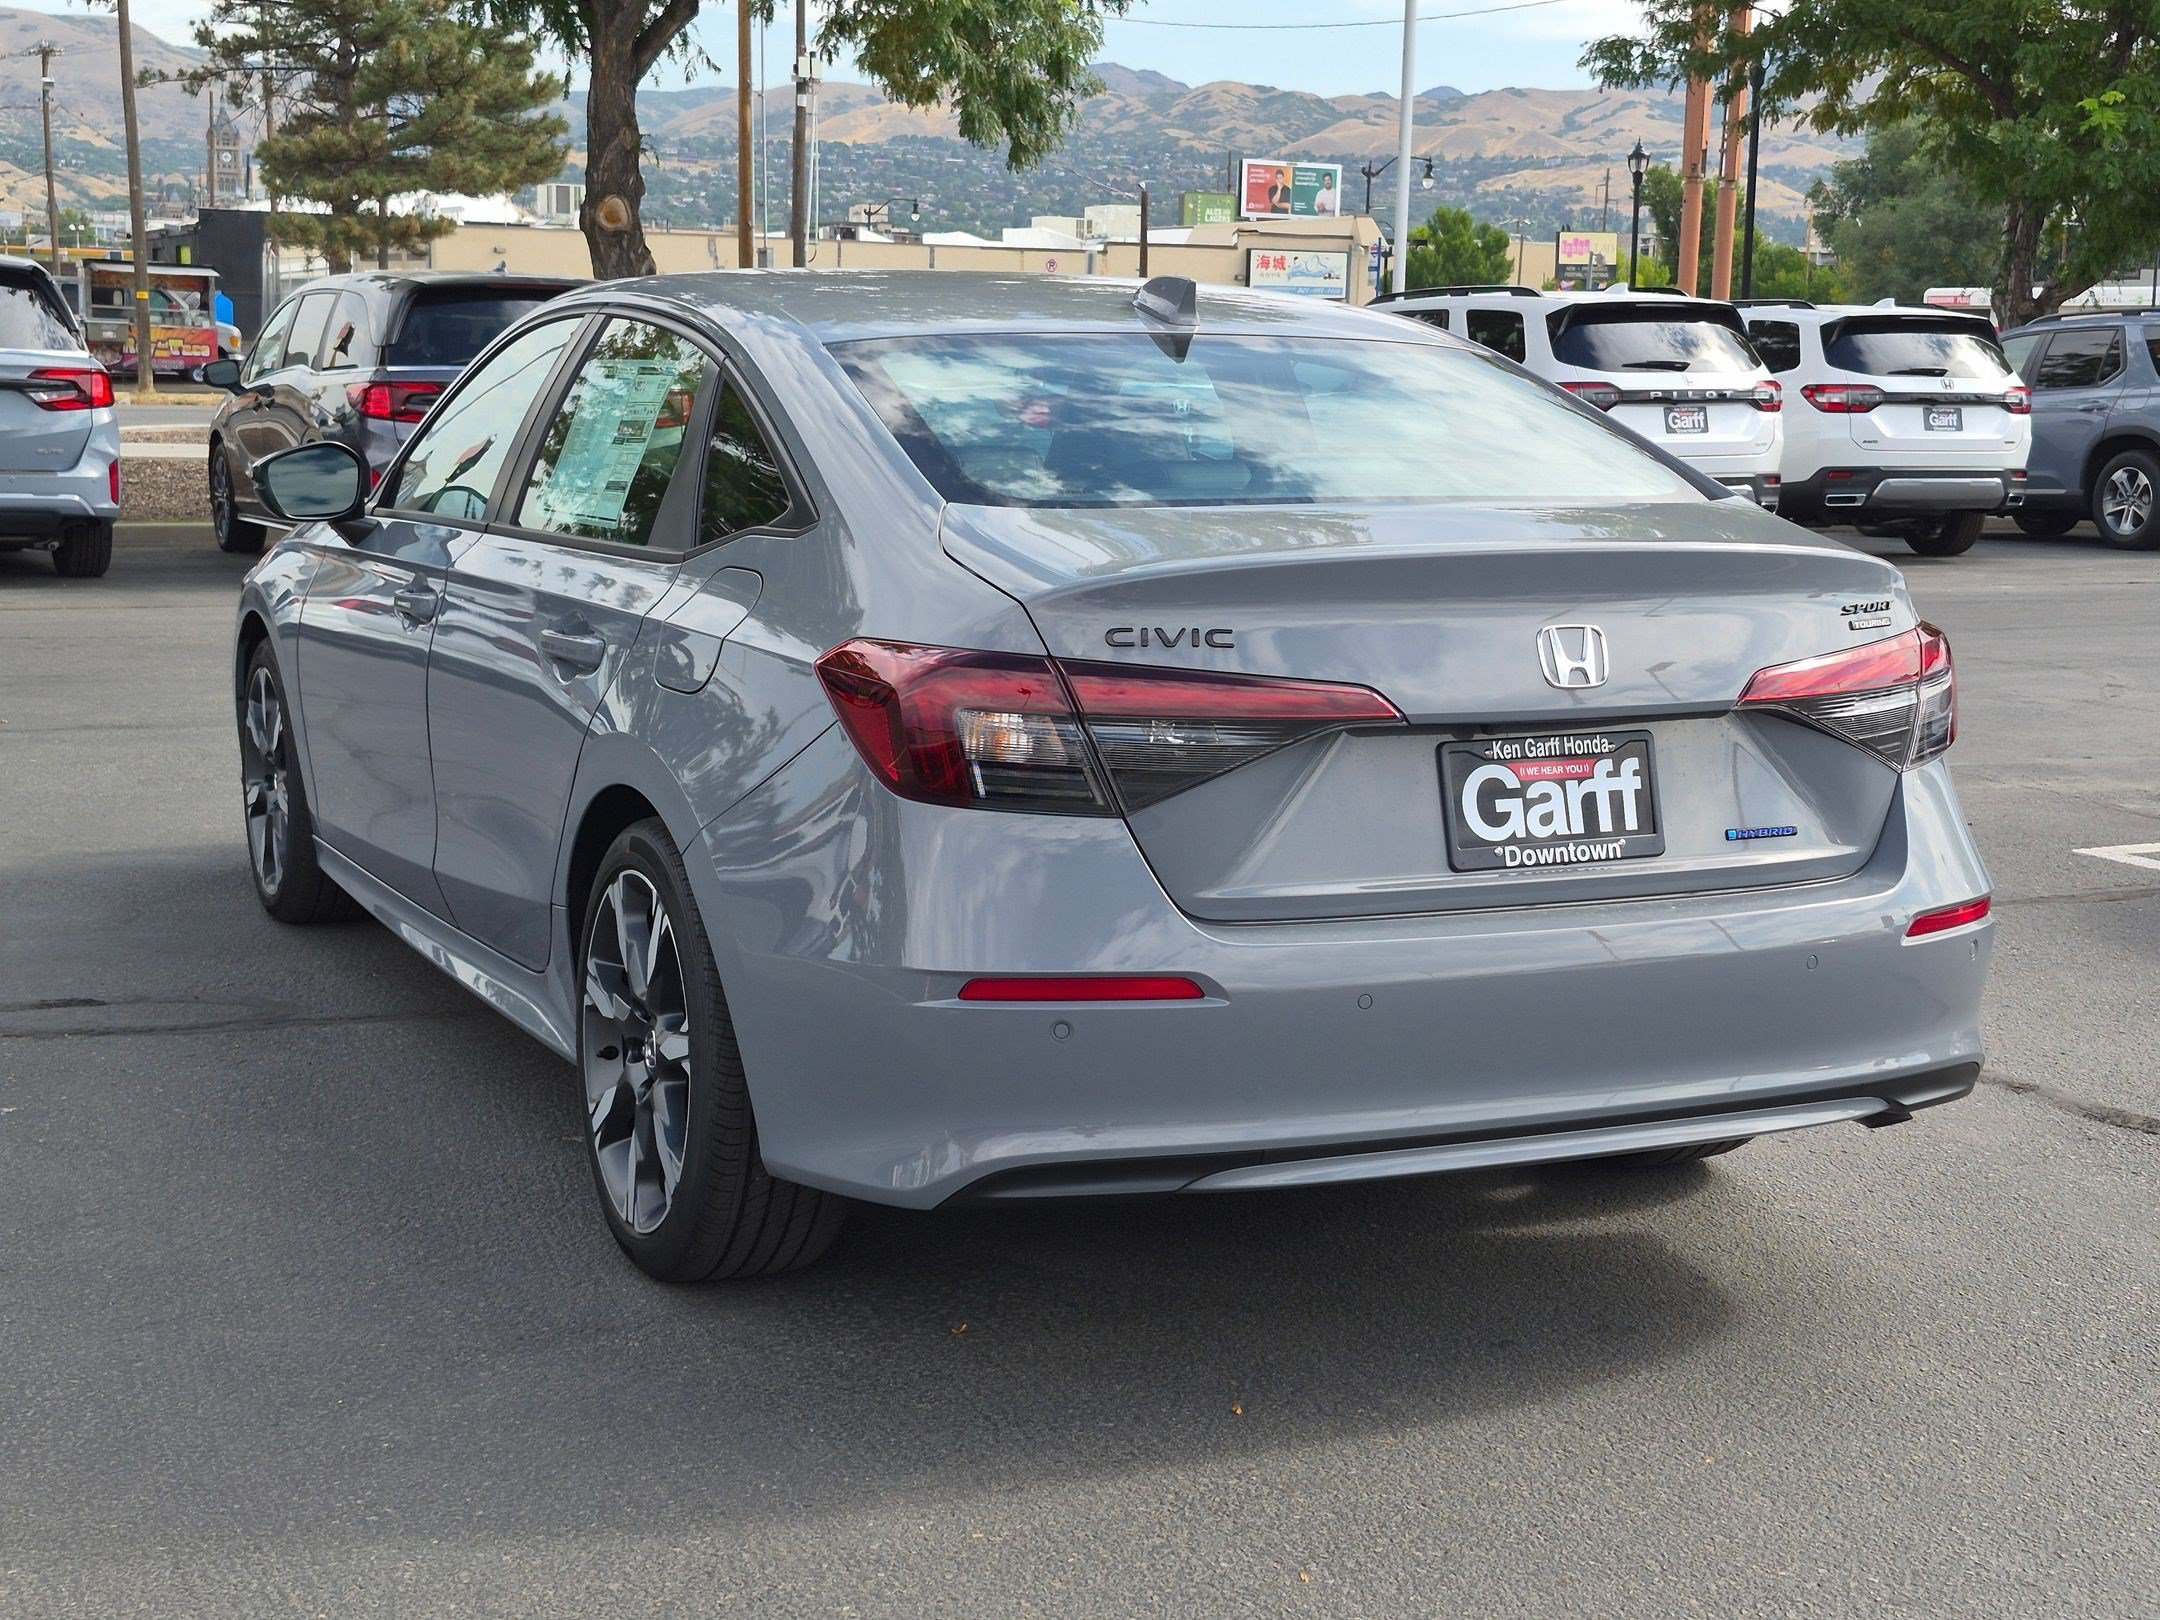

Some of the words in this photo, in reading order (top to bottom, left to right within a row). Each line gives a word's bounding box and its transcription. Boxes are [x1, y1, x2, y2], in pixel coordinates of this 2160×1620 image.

[1650, 391, 1734, 399] PILOT
[1668, 412, 1705, 429] Garff
[1929, 412, 1958, 427] Garff
[1853, 617, 1891, 629] TOURING
[1105, 627, 1235, 649] CIVIC
[1492, 740, 1521, 760] Ken
[1524, 736, 1560, 758] Garff
[1564, 735, 1609, 756] Honda
[1526, 767, 1540, 776] WE
[1541, 766, 1563, 775] HEAR
[1565, 765, 1583, 774] YOU
[1462, 757, 1642, 842] Garff
[1738, 826, 1794, 839] HYBRID
[1505, 841, 1622, 868] Downtown
